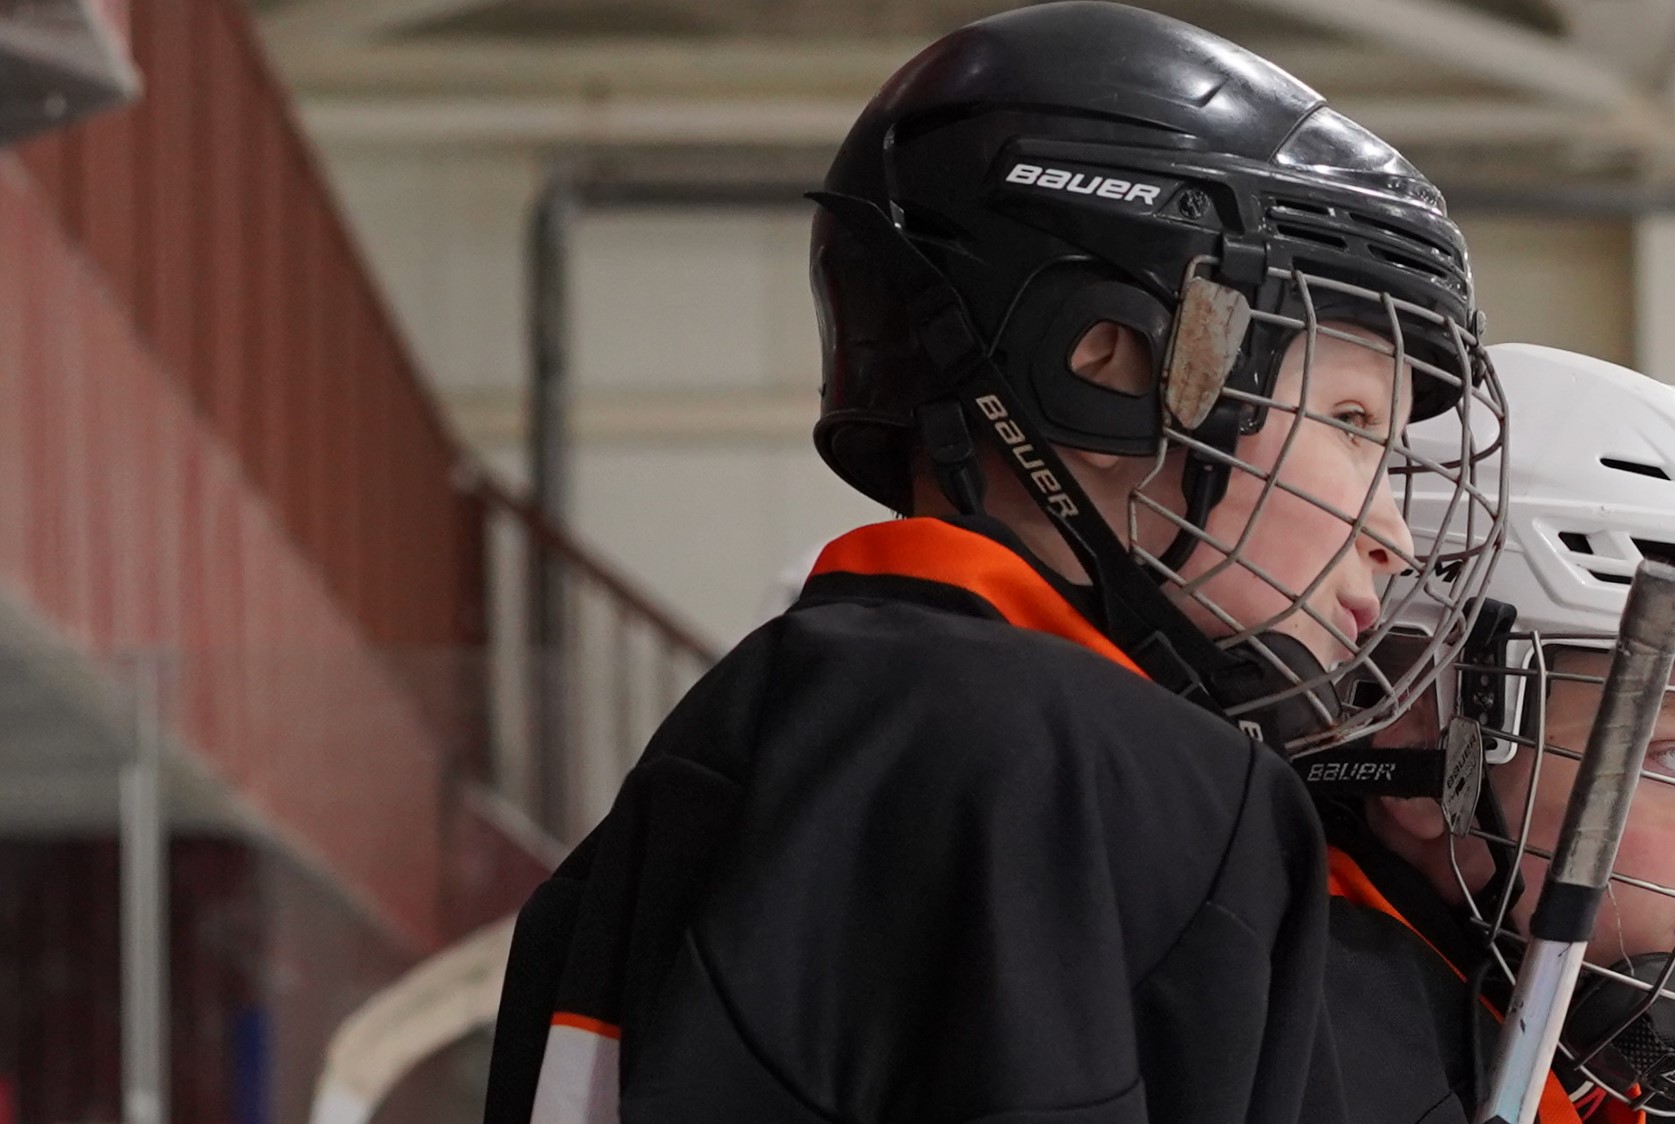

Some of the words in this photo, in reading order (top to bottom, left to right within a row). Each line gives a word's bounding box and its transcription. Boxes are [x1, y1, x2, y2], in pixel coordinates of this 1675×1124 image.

[1005, 162, 1163, 207] BAUER
[975, 393, 1079, 520] BAUER
[1306, 761, 1397, 782] BAUER
